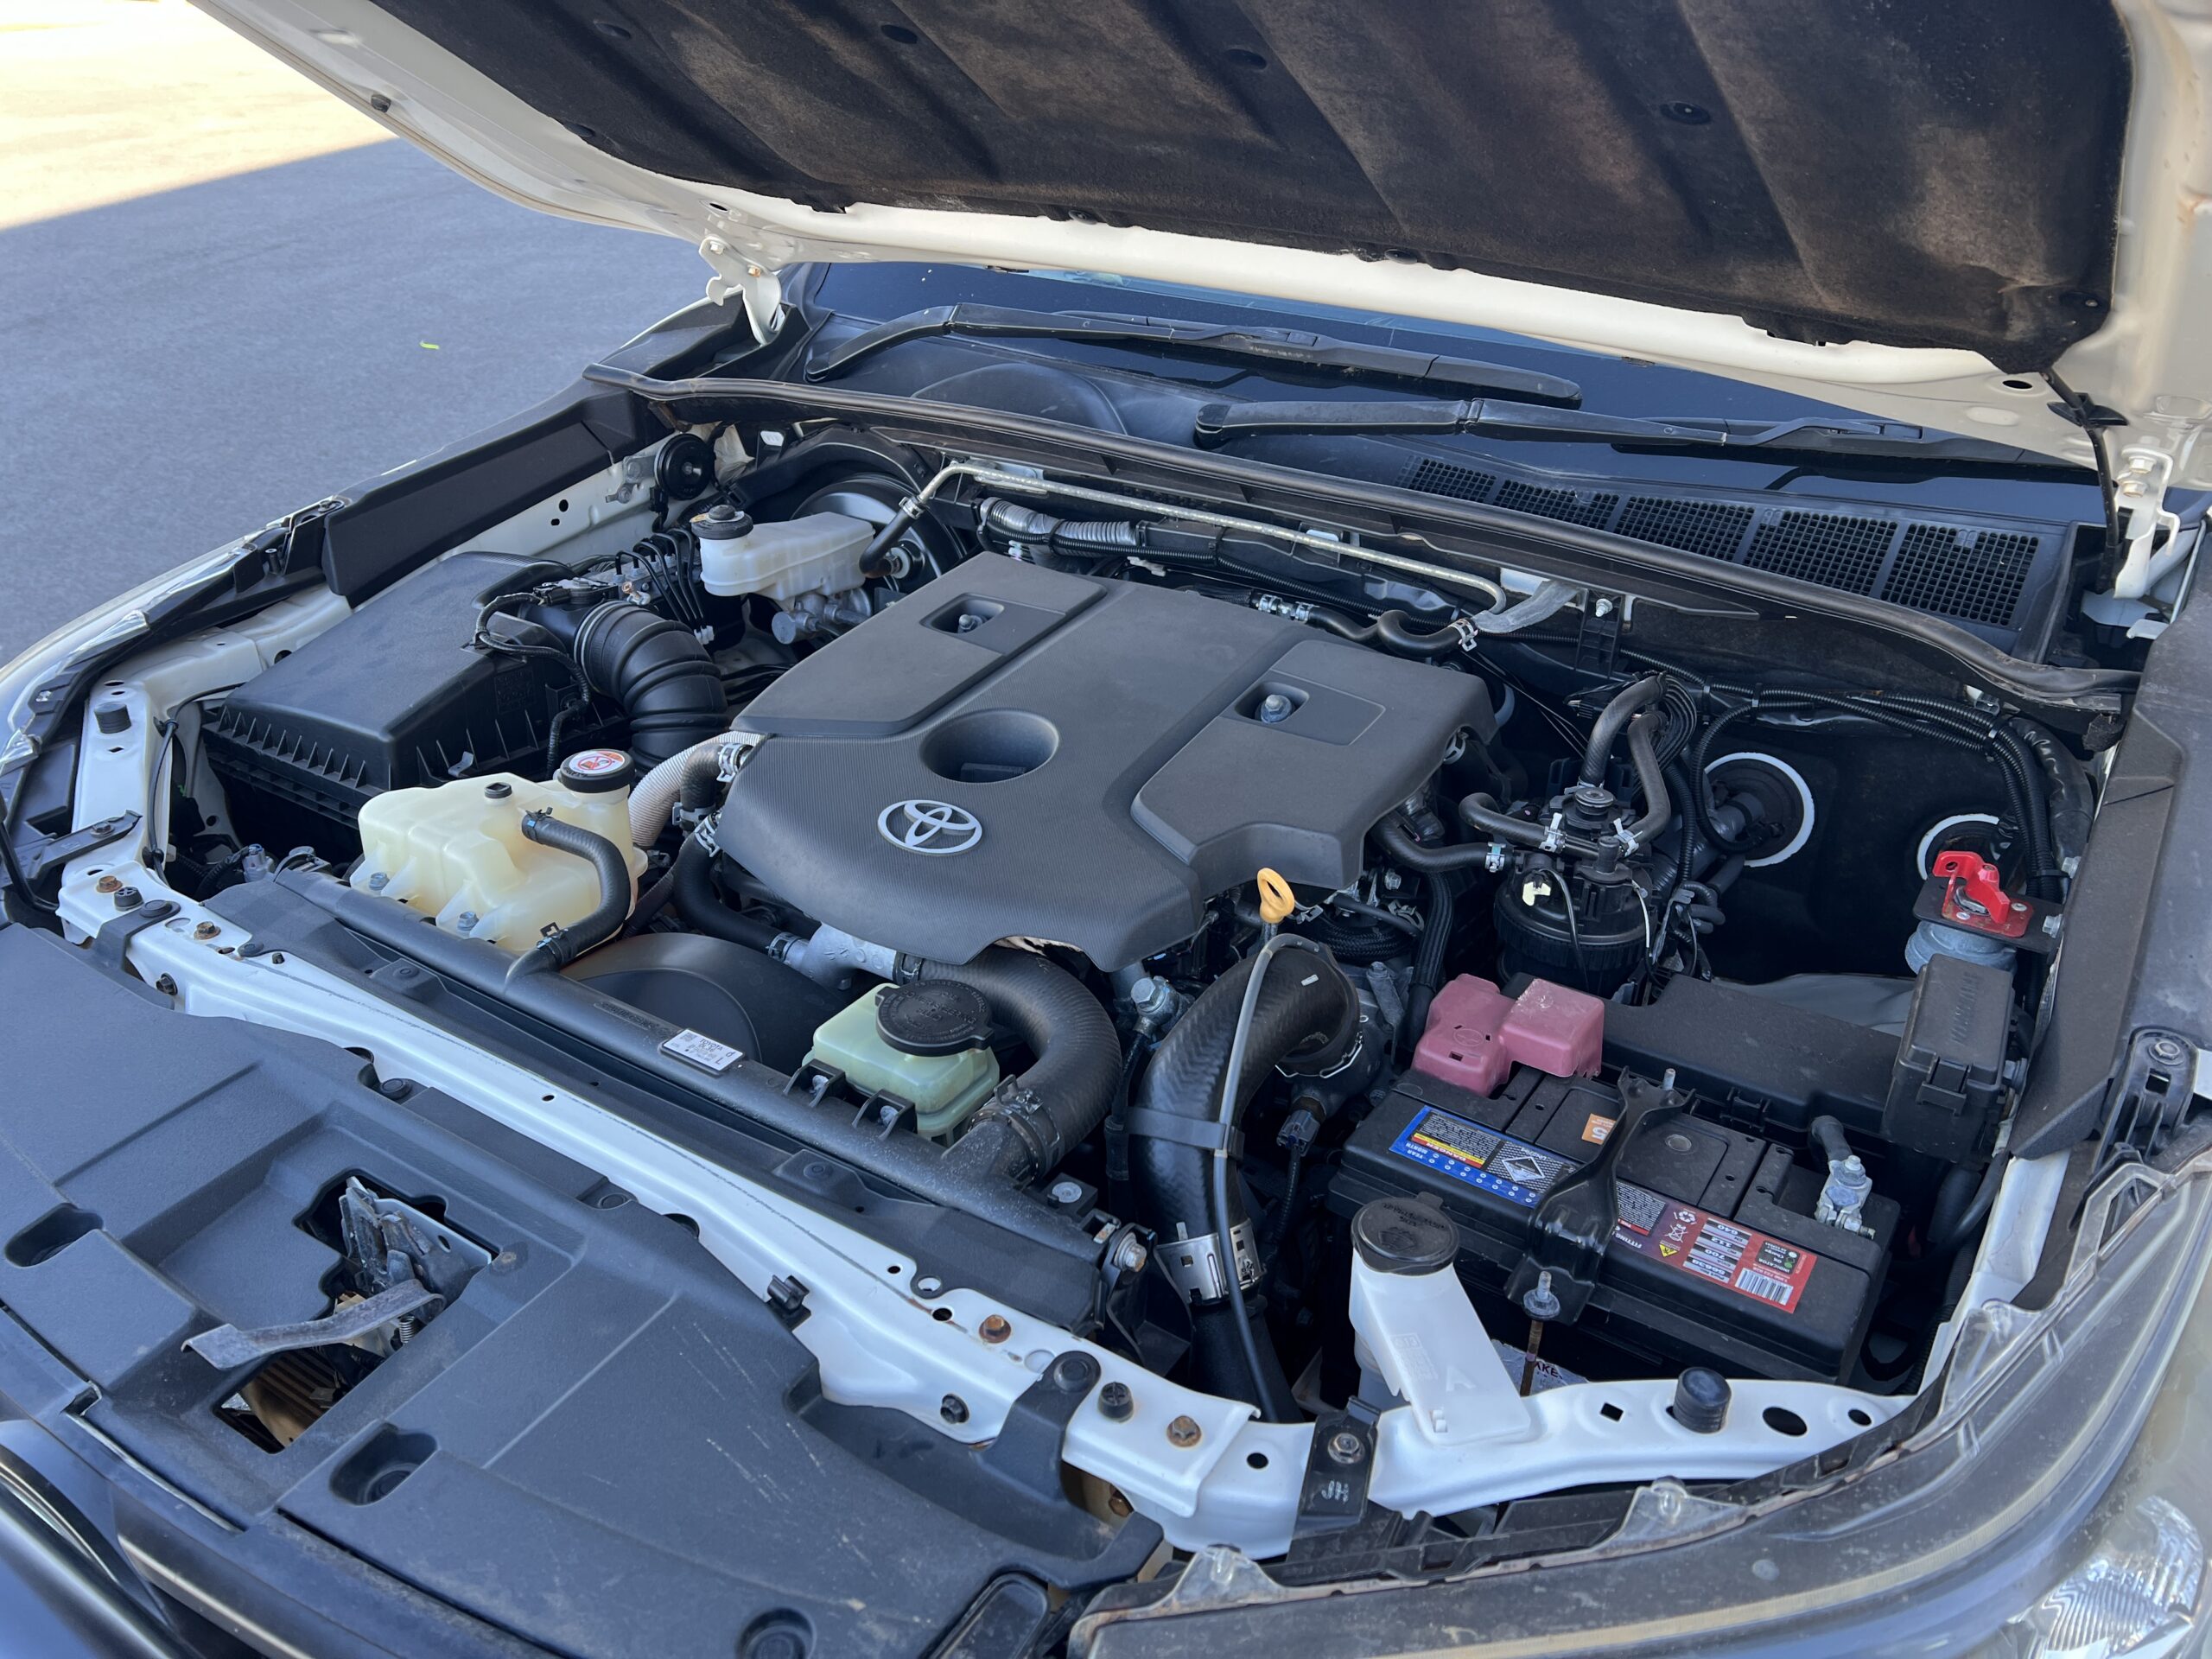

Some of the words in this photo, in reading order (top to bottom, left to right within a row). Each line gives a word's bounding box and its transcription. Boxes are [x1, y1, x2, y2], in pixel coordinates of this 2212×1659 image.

[699, 1038, 723, 1051] TOYOTA
[1405, 1141, 1427, 1154] MONTH
[1406, 1148, 1424, 1159] YEAR
[1425, 1141, 1466, 1161] DANGER
[1716, 1224, 1738, 1235] 640
[1616, 1232, 1642, 1249] FITTING
[1710, 1236, 1732, 1248] 112
[1703, 1248, 1726, 1260] 700
[1764, 1248, 1784, 1259] Charge
[1758, 1257, 1790, 1273] INDICATOR
